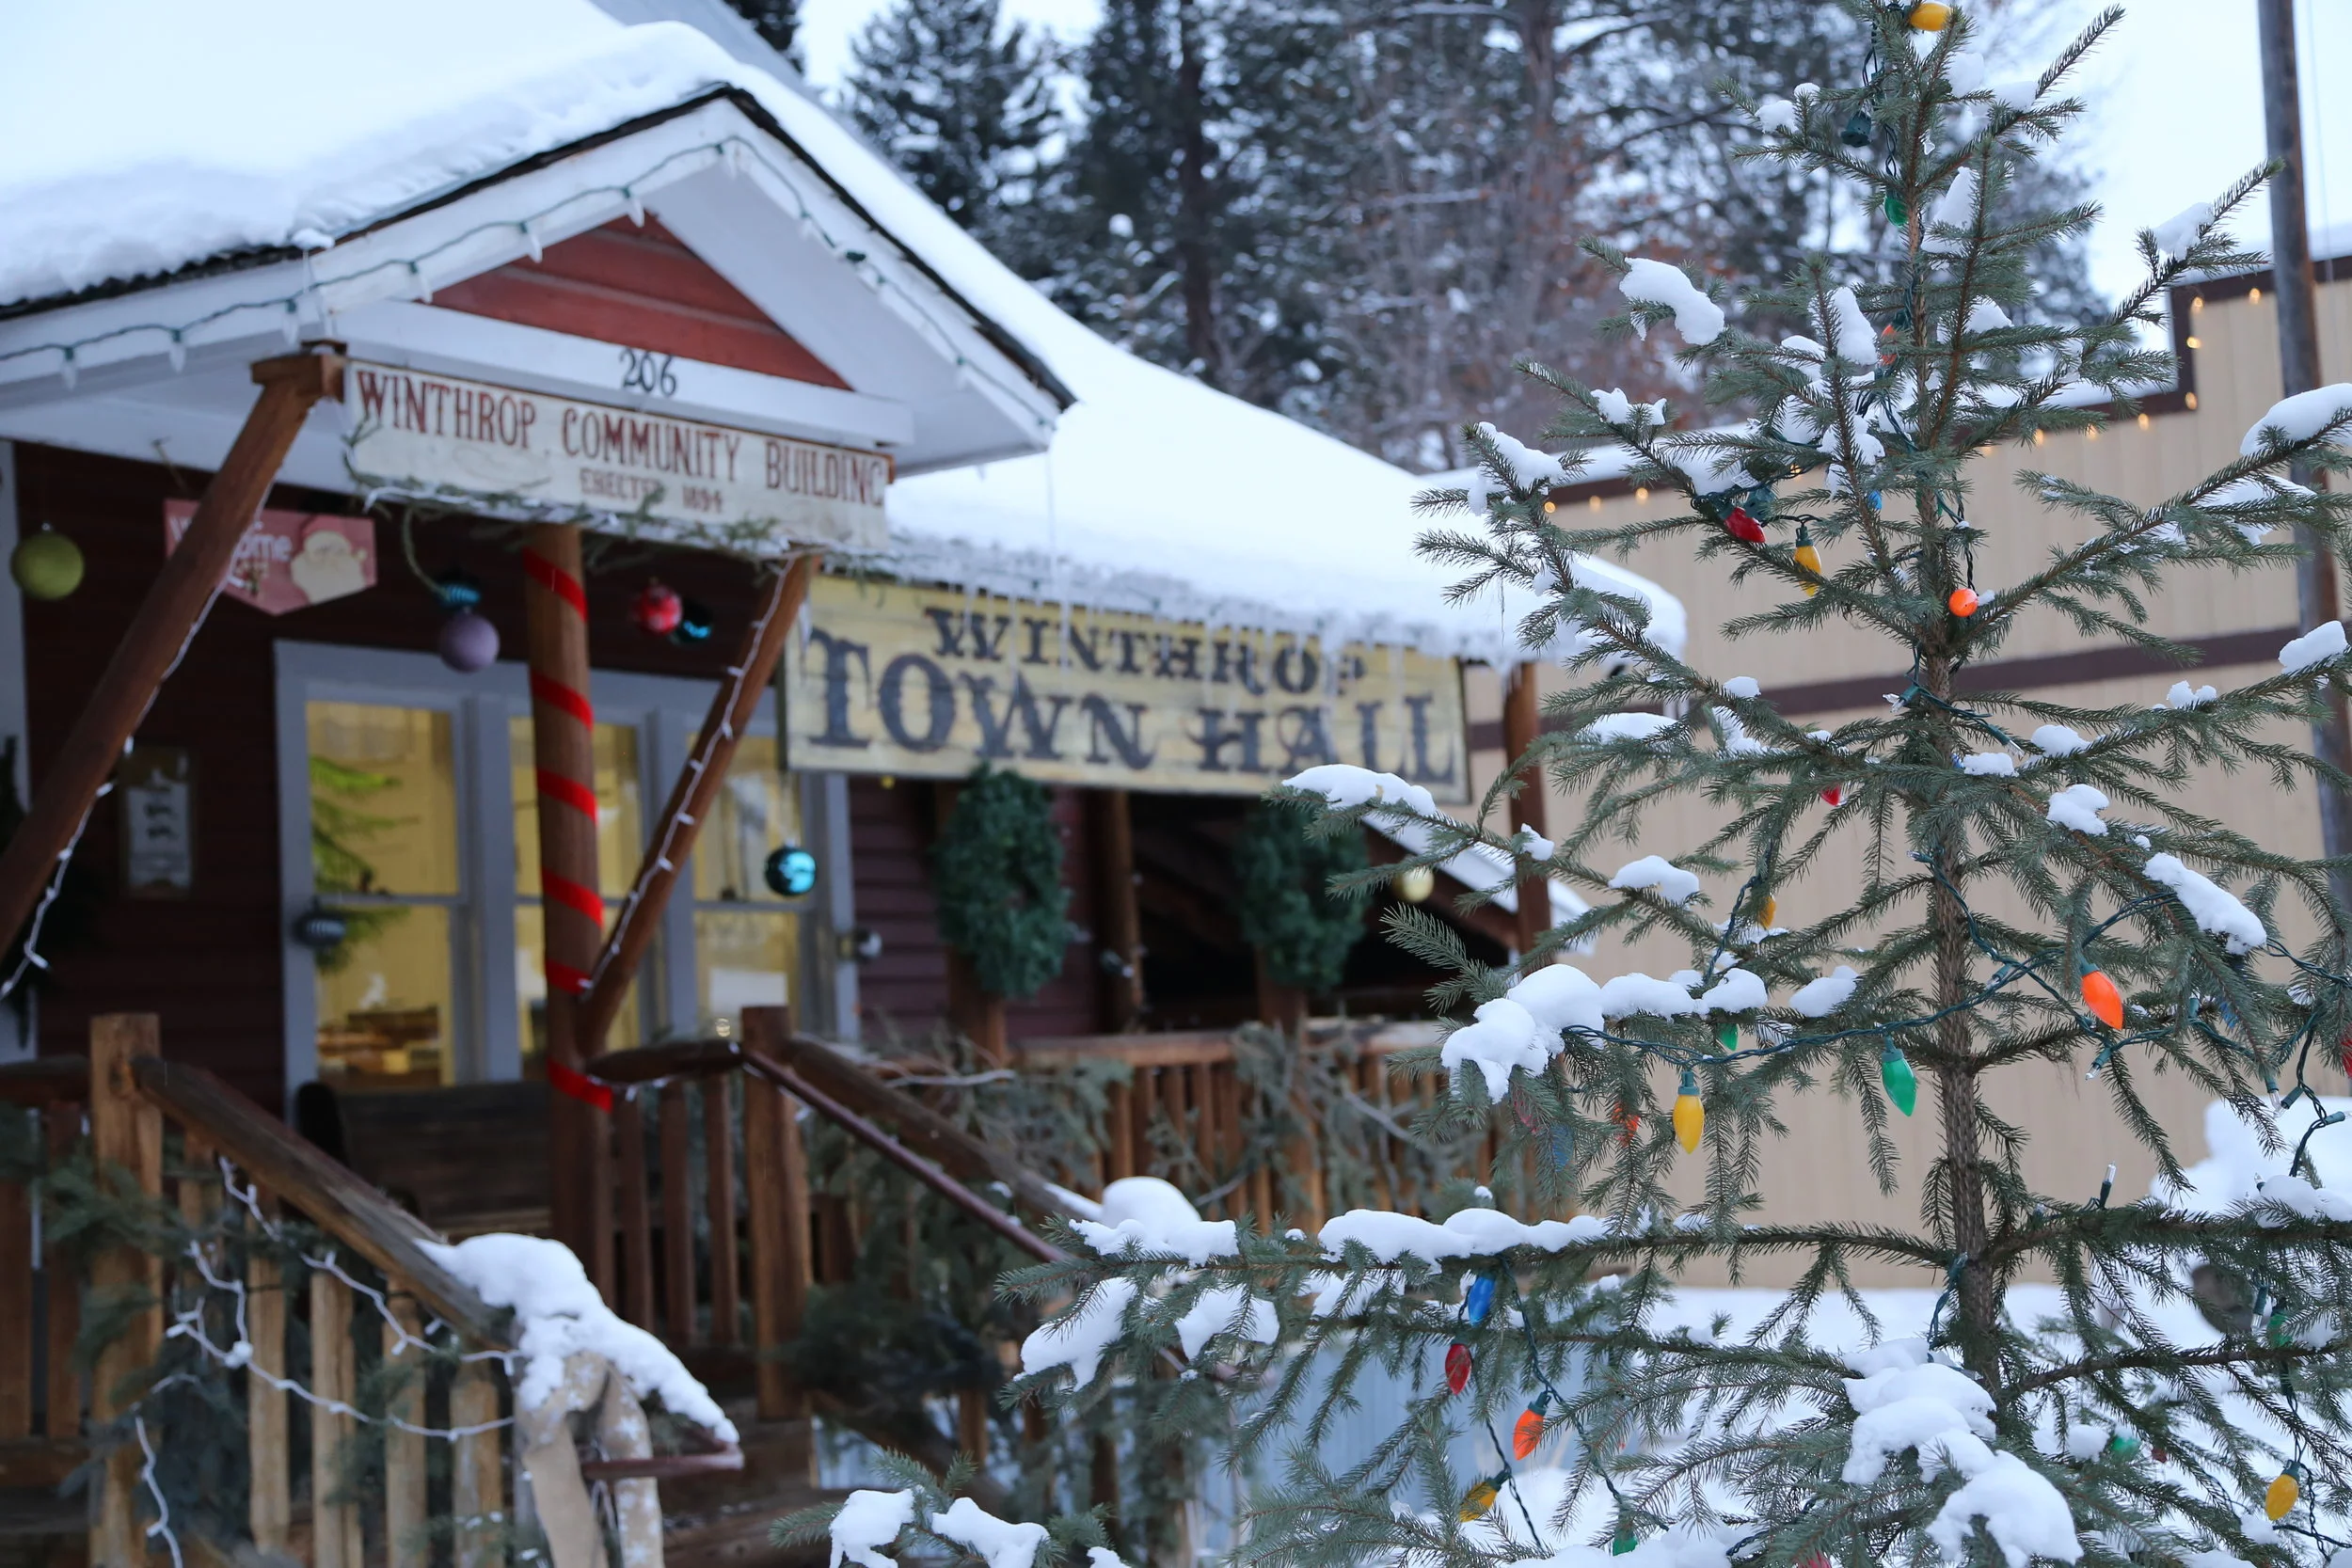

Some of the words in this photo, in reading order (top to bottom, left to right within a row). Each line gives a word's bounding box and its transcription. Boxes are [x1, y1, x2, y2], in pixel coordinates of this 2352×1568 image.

[620, 348, 678, 397] 206
[357, 370, 536, 450] WINTHROP
[562, 406, 741, 483] COMMUNITY
[765, 438, 884, 508] BUILDING
[800, 627, 1158, 771] TOWN
[1187, 691, 1455, 784] HALL
[923, 607, 1366, 698] WINTHROP
